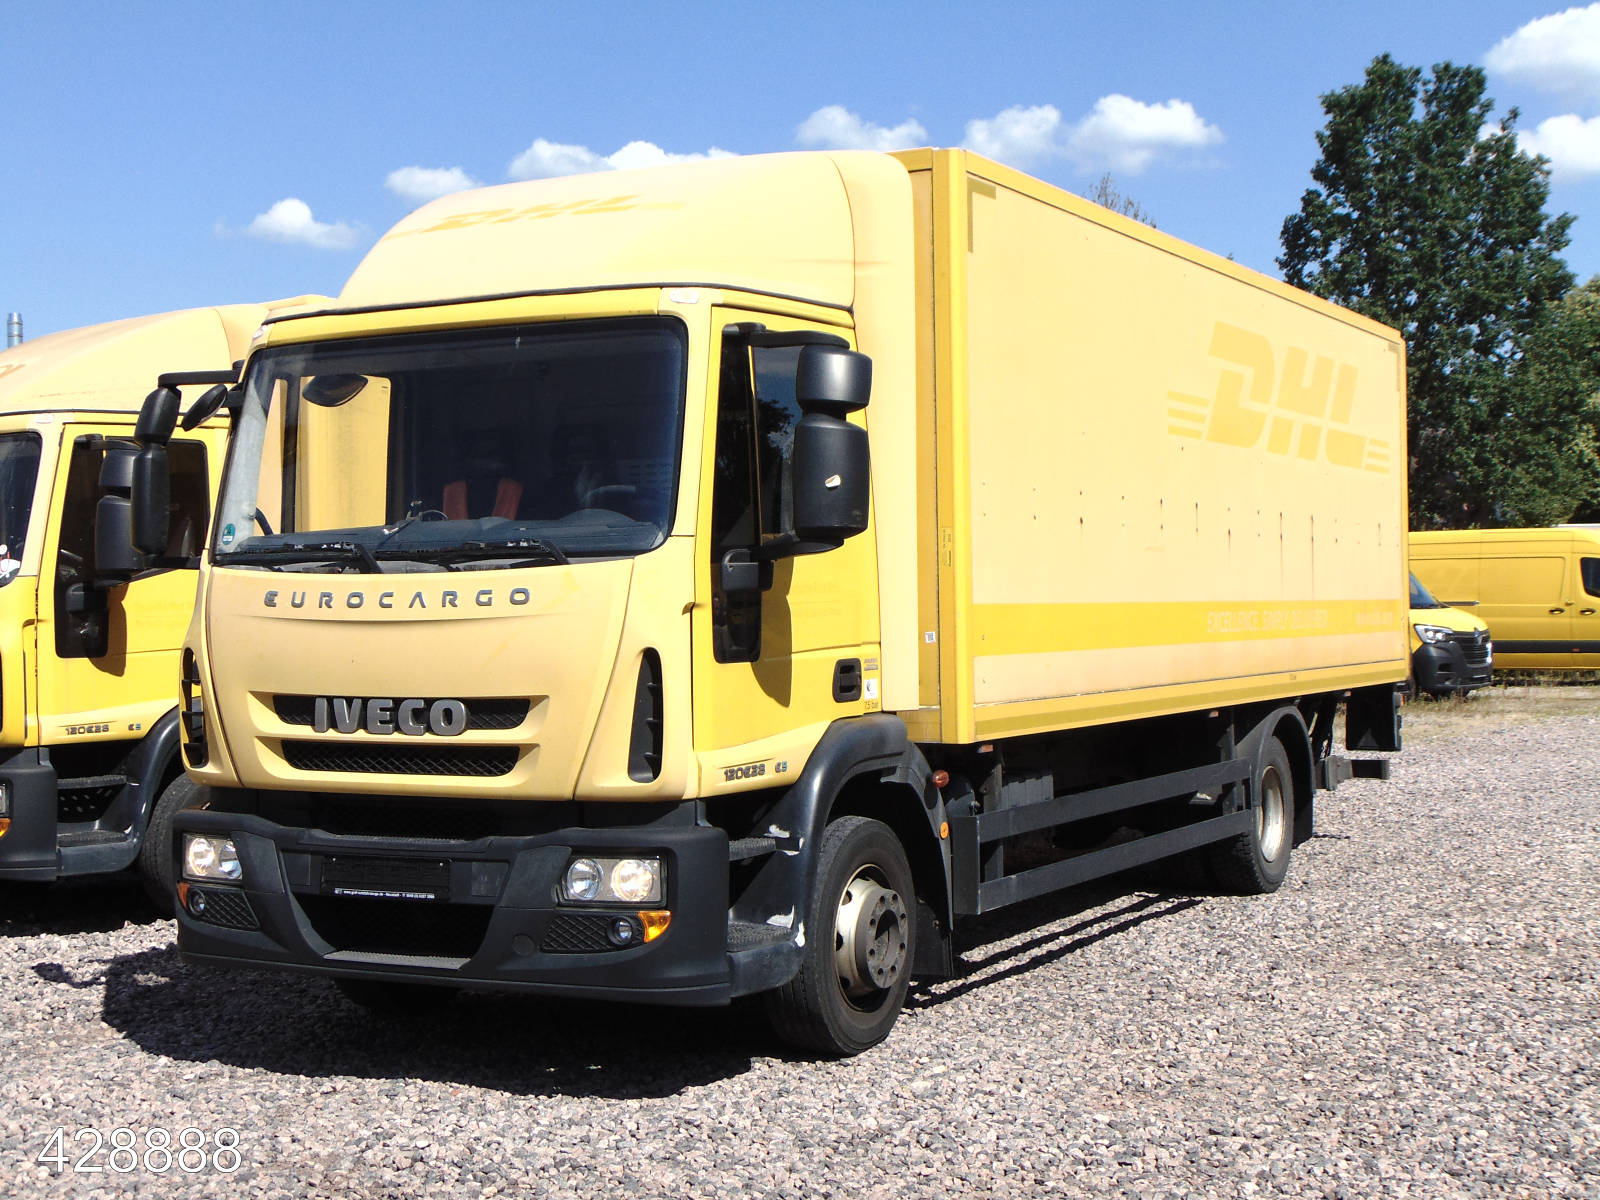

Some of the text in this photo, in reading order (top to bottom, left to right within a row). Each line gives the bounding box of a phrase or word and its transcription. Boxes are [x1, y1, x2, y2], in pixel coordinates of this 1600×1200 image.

[1206, 320, 1368, 470] DHL
[263, 587, 531, 609] EUROCARGO
[312, 696, 468, 737] IVECO
